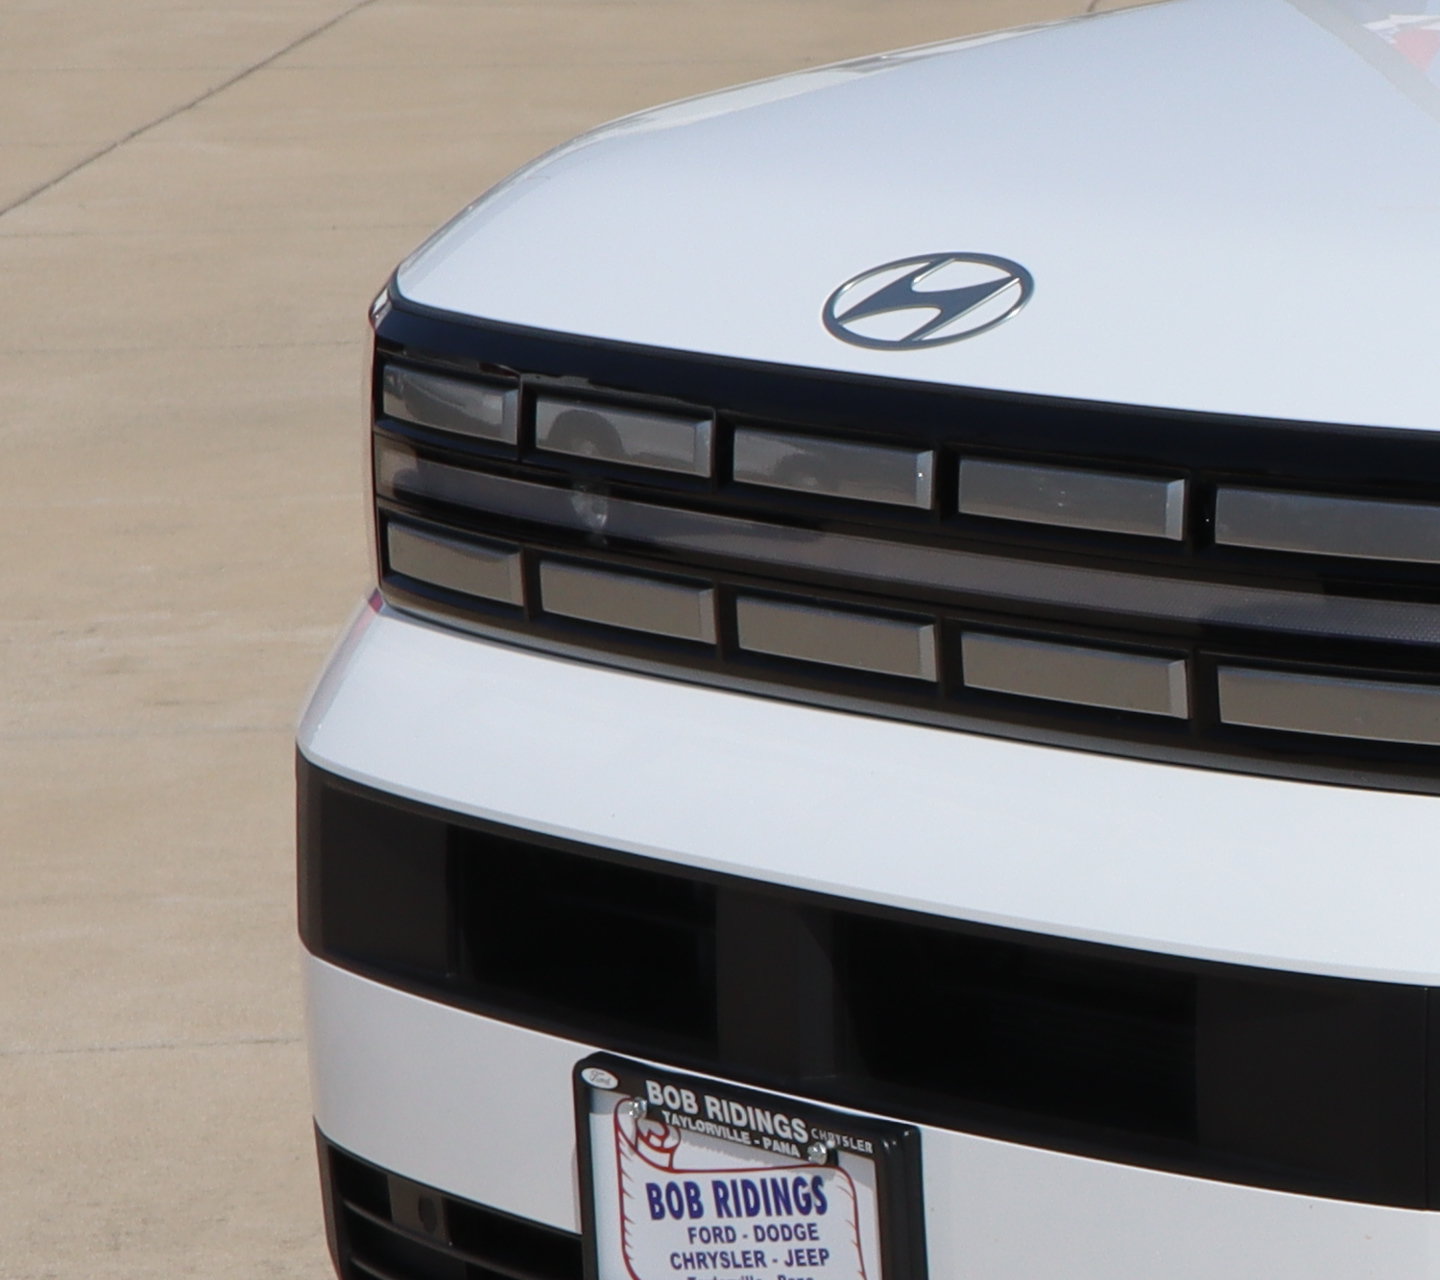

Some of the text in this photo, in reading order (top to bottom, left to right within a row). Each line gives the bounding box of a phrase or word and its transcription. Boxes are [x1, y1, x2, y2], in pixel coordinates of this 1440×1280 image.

[645, 1080, 809, 1143] BOB RIDINGS
[661, 1110, 751, 1145] TAYLORVILLE
[762, 1137, 800, 1157] PANA
[811, 1128, 874, 1154] CHRYSLER
[645, 1175, 828, 1220] BOB RIDINGS
[687, 1226, 737, 1244] FORD
[753, 1222, 820, 1243] DODGE
[670, 1250, 767, 1270] CHRYSLER
[784, 1248, 830, 1267] JEEP
